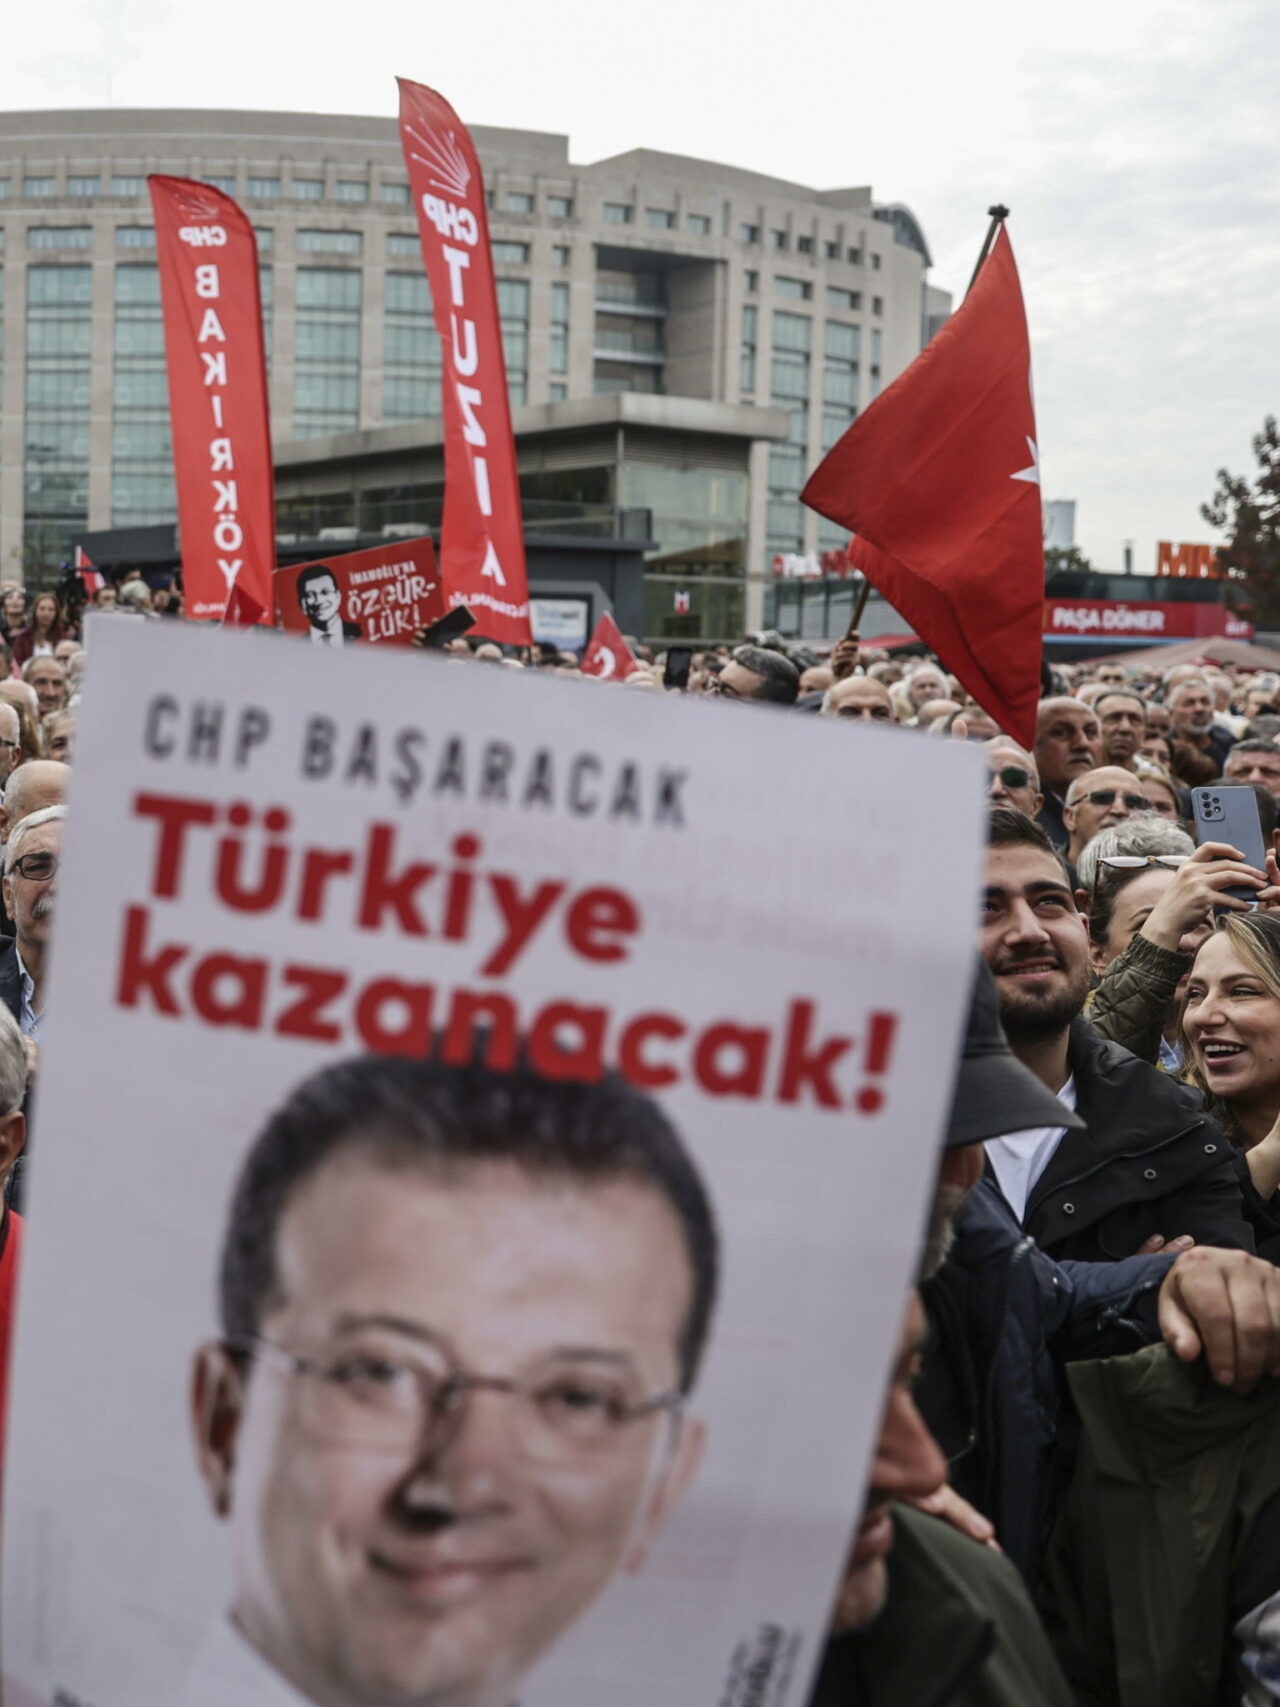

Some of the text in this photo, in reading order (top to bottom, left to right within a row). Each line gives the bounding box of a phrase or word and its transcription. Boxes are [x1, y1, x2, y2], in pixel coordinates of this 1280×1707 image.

[367, 603, 420, 642] LÜK!
[1053, 603, 1166, 634] PAŞA DÖNER
[145, 694, 694, 827] CHP BAŞARACAK
[134, 792, 643, 979] Türkiye
[116, 904, 900, 1118] kazanacak!
